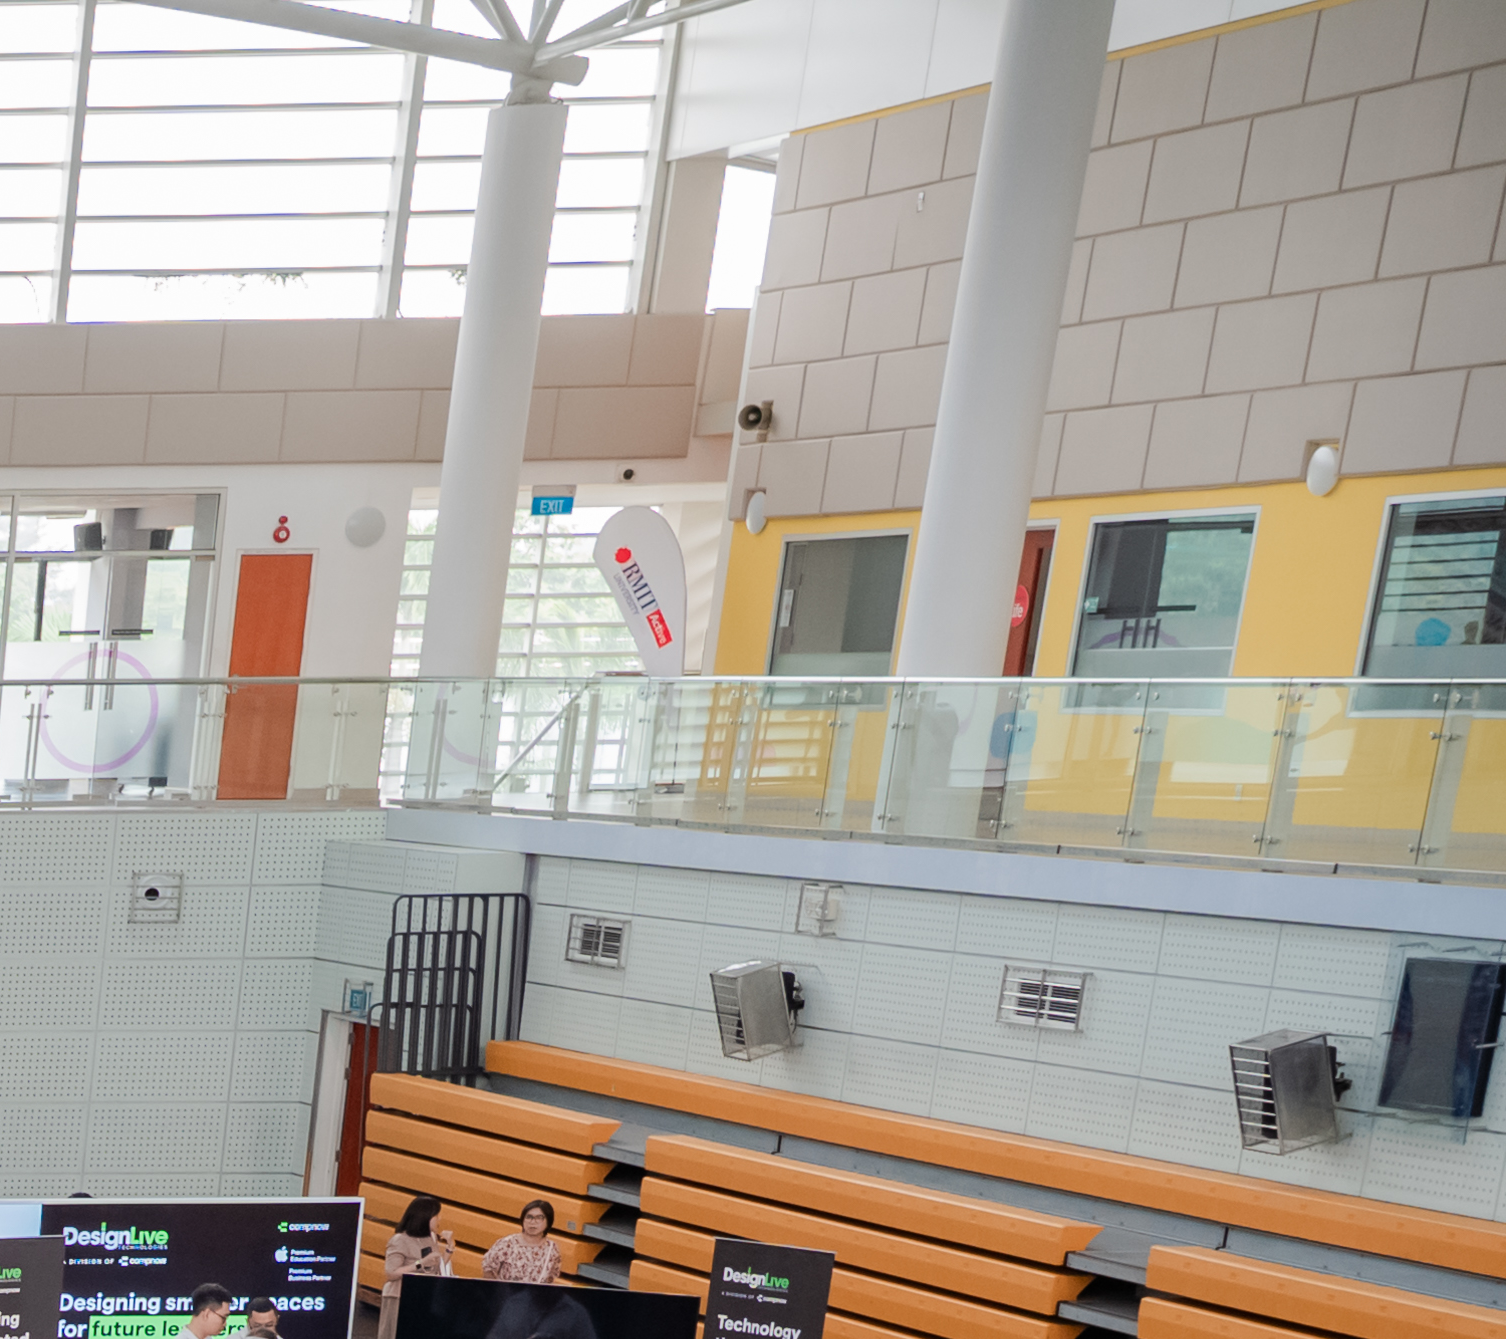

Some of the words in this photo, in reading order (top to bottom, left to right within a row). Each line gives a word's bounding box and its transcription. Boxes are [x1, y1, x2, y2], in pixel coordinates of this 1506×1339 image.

[540, 500, 564, 514] EXIT
[613, 572, 640, 615] UNIVERSITY
[622, 560, 660, 610] RMIT
[649, 614, 667, 644] Active
[62, 1222, 169, 1250] DesignLive
[723, 1266, 790, 1289] DesignLive
[58, 1292, 161, 1315] Designing
[57, 1319, 87, 1338] for
[92, 1320, 156, 1337] future
